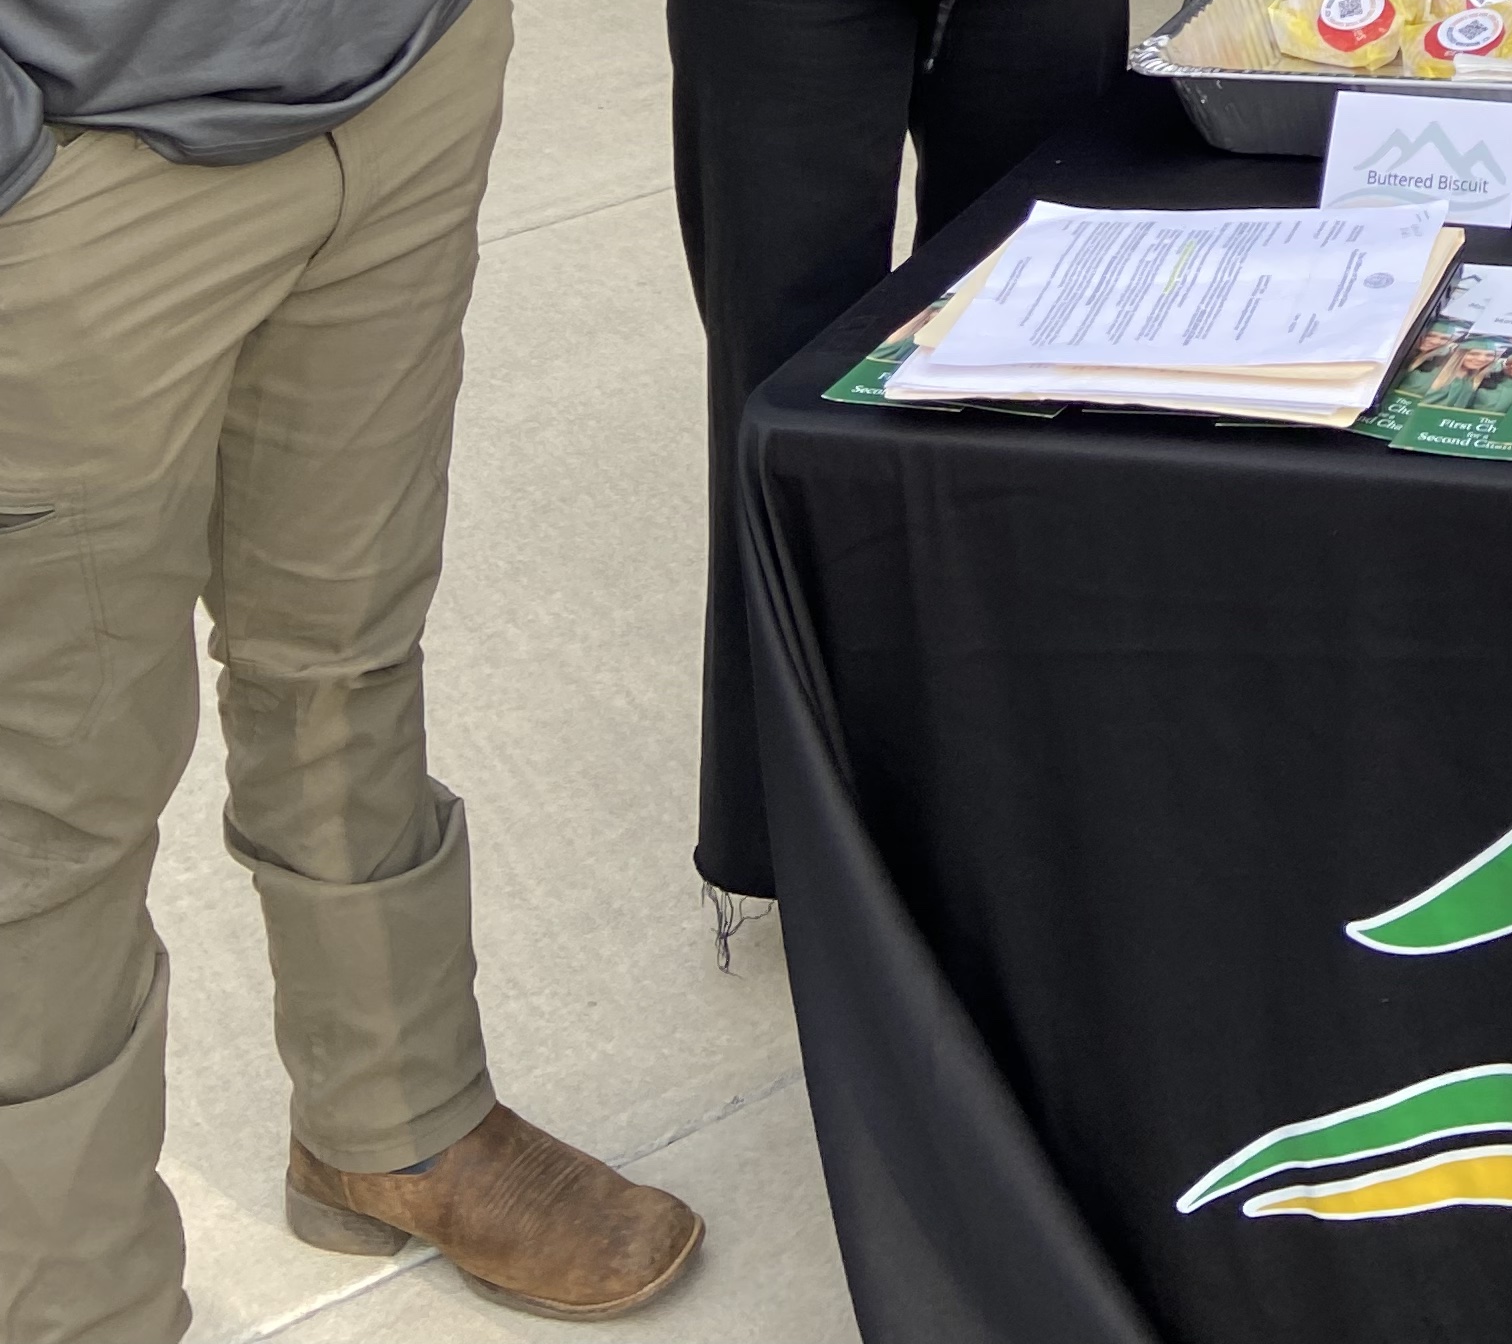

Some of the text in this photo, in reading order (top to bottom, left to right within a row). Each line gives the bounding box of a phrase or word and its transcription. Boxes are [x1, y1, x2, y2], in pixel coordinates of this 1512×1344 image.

[1367, 170, 1489, 193] Buttered Biscuit
[1439, 419, 1472, 431] First
[1417, 432, 1471, 447] Second
